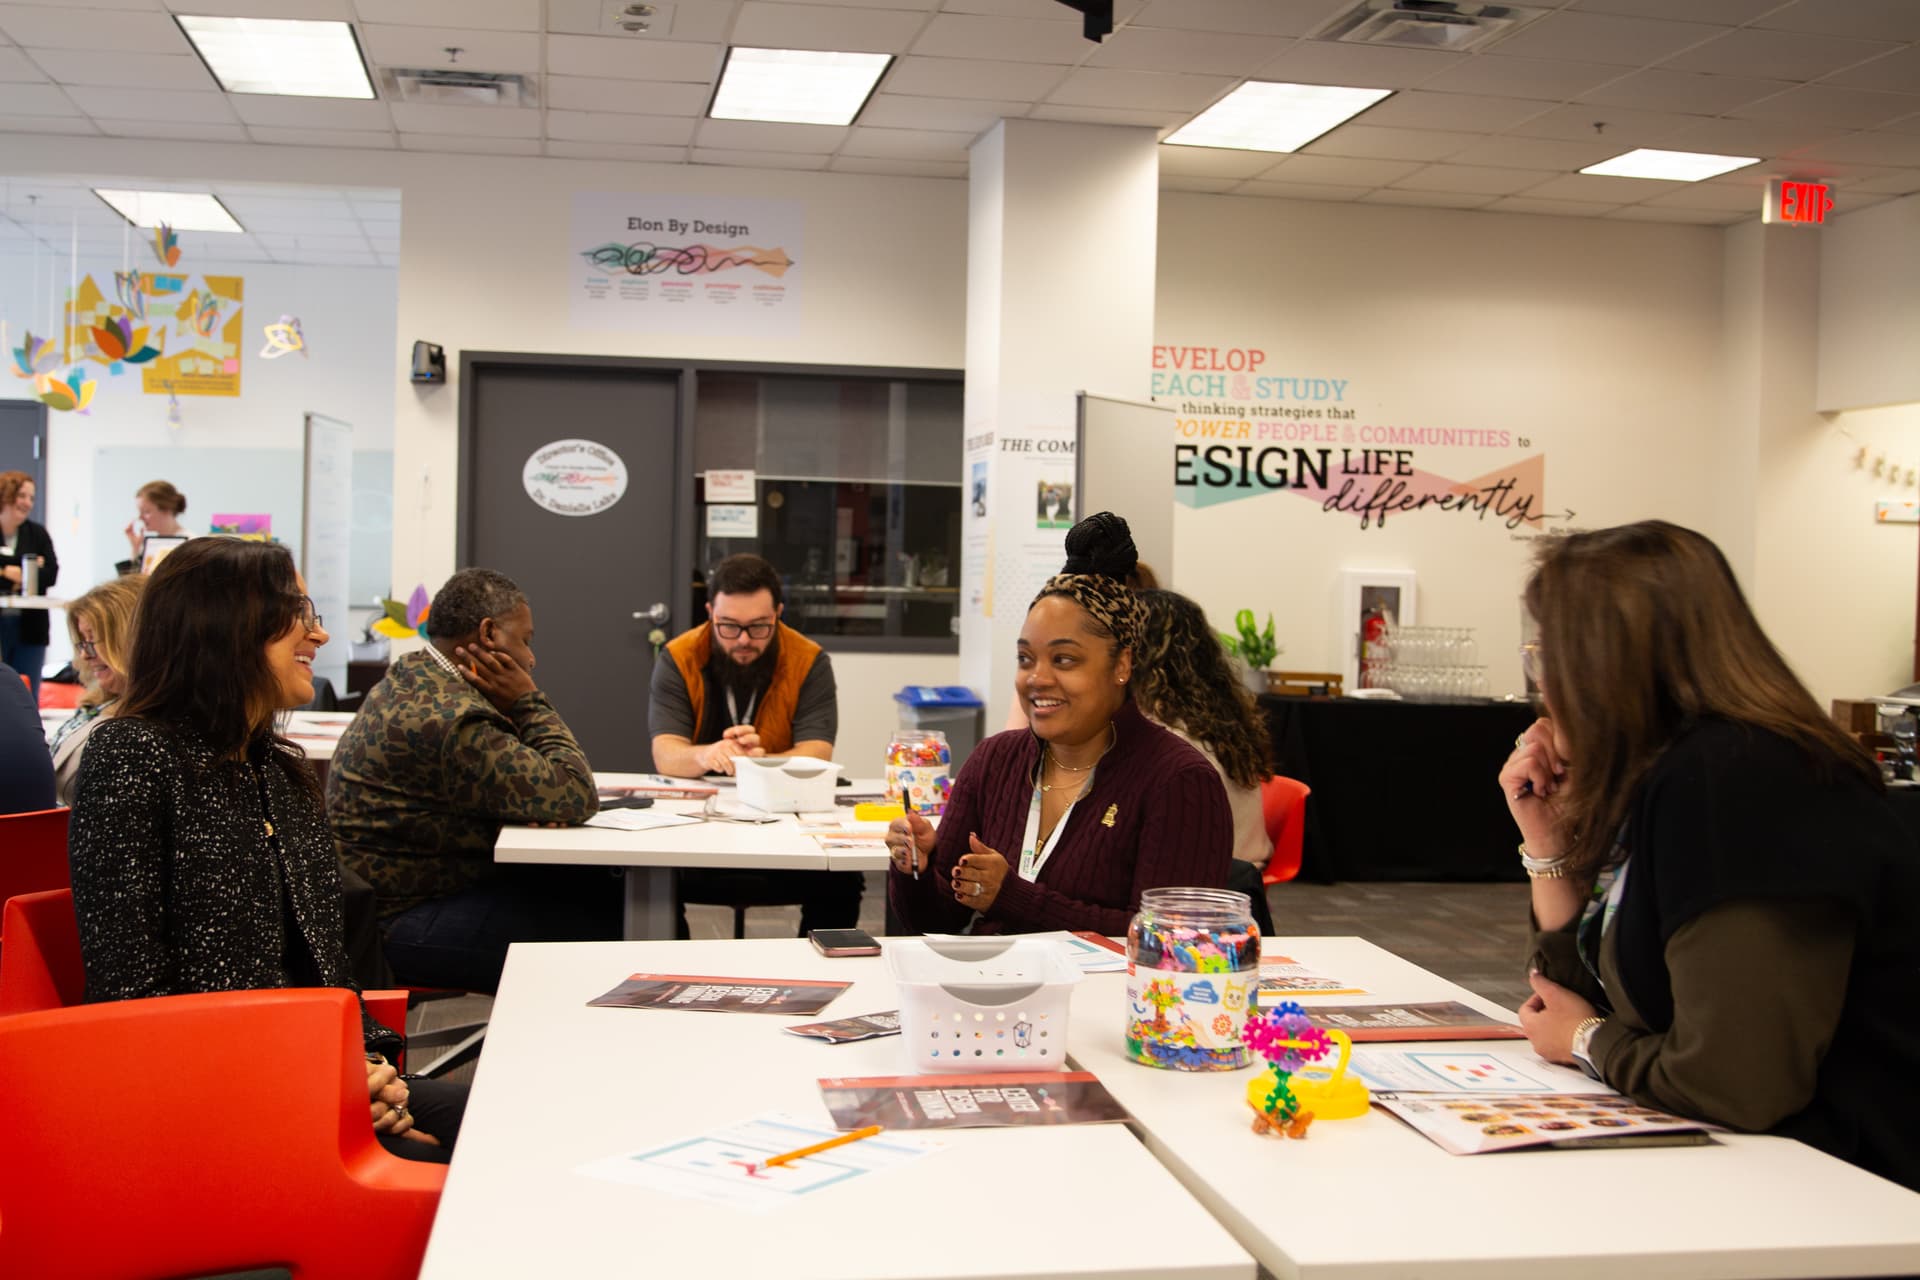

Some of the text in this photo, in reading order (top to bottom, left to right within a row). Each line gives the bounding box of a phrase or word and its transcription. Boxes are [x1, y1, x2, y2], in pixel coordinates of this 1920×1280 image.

[1780, 181, 1828, 224] EXIT
[627, 217, 750, 238] Elon By Design
[1152, 345, 1266, 372] EVELOP
[1151, 373, 1226, 397] EACH
[1255, 377, 1349, 402] STUDY
[1182, 403, 1356, 420] thinking strategies that
[1000, 438, 1033, 453] THE
[1257, 422, 1337, 442] PEOPLE
[1359, 425, 1511, 448] COMMUNITIES
[1518, 436, 1531, 448] to
[1175, 444, 1414, 489] ESIGN LIFE
[1322, 478, 1544, 530] differently
